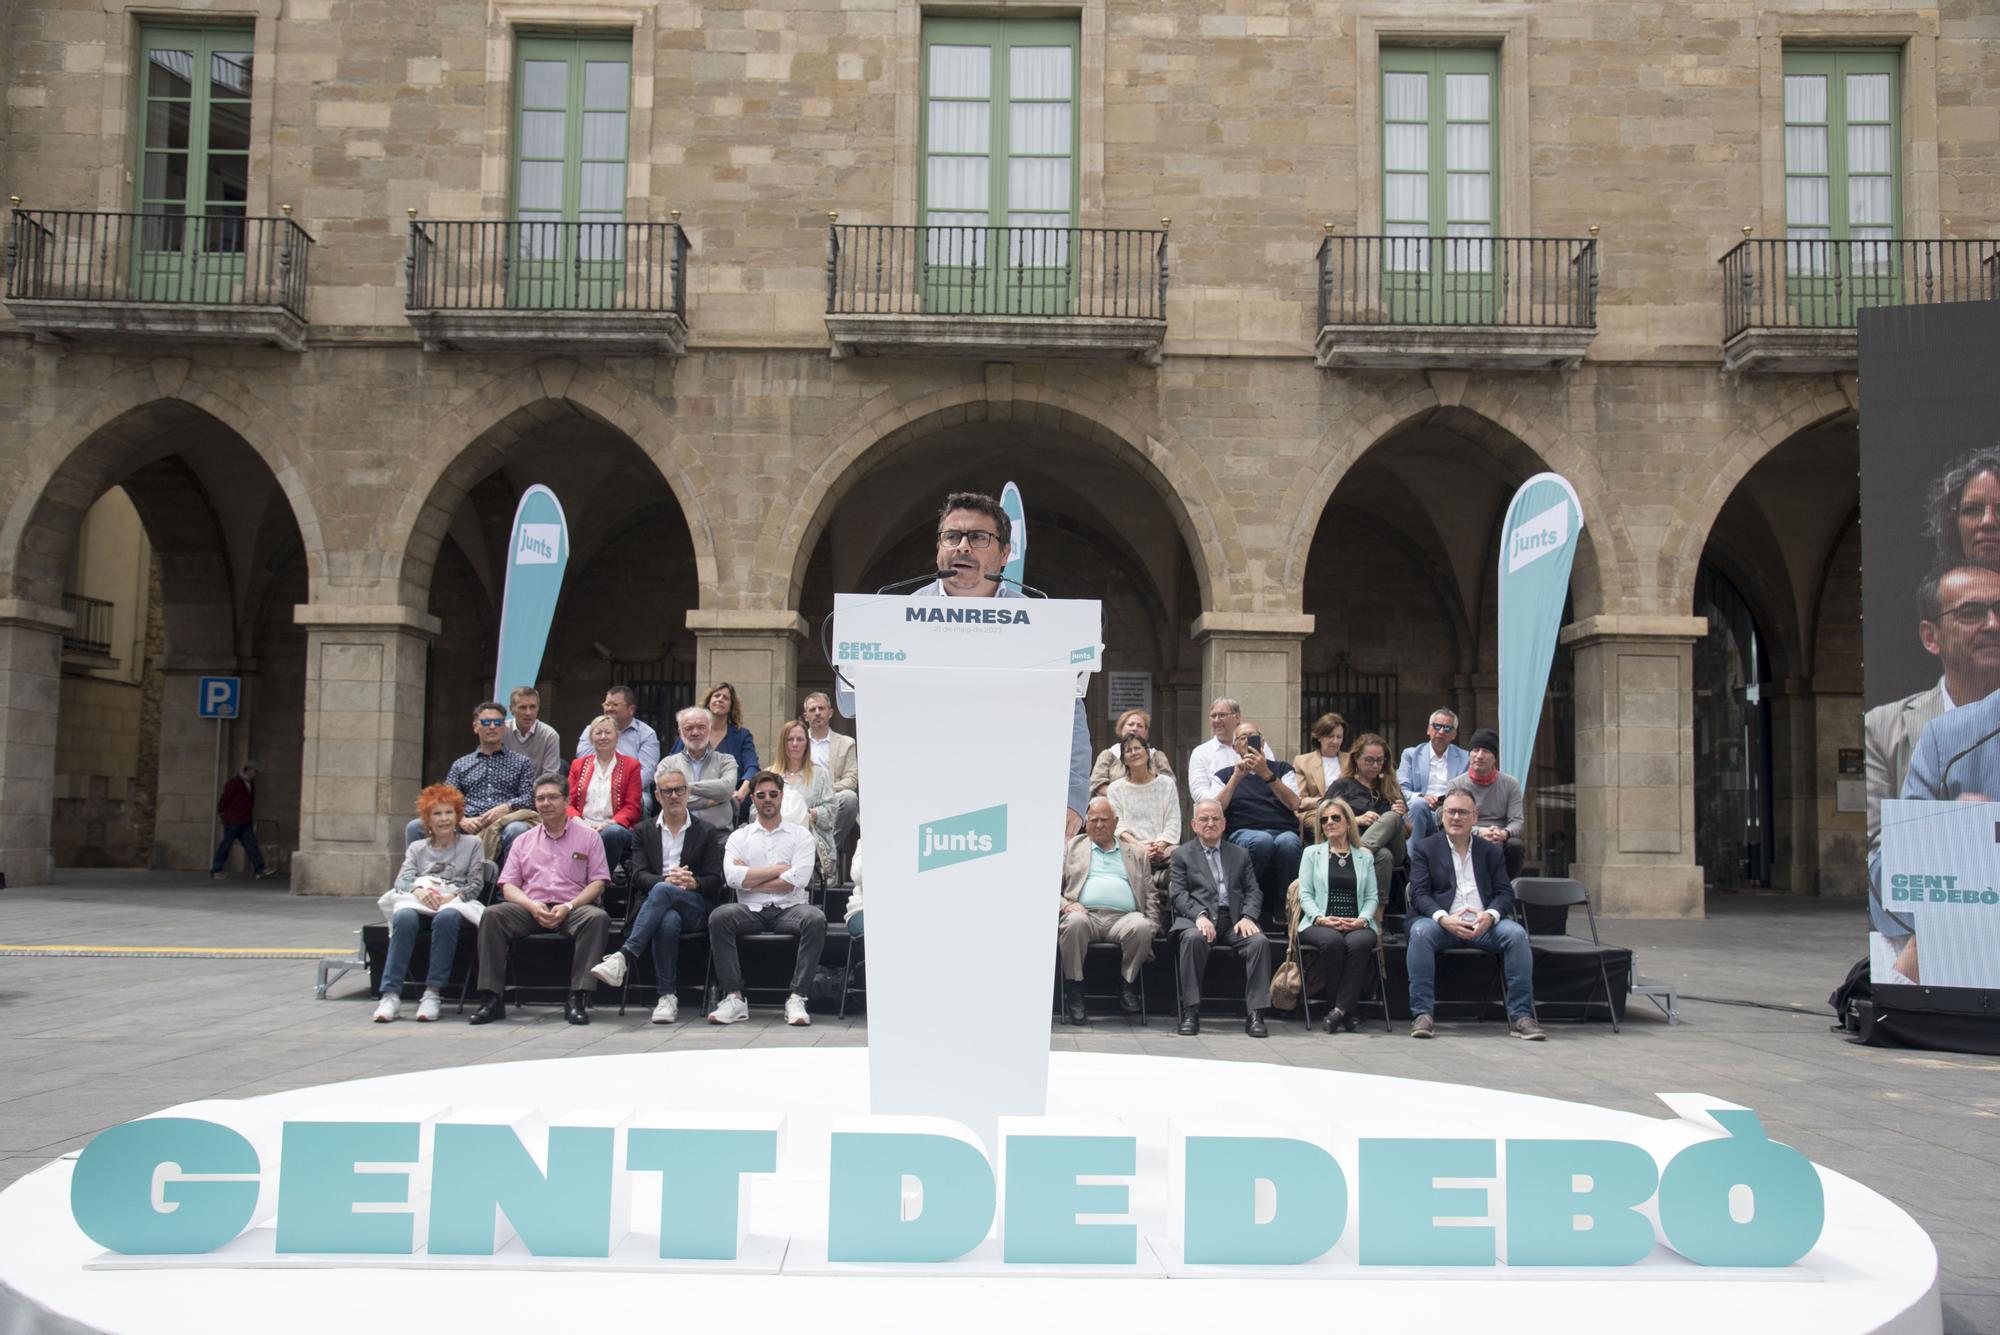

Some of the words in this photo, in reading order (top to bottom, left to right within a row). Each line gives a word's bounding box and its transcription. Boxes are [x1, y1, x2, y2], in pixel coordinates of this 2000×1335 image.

[520, 528, 552, 559] junts
[1513, 528, 1558, 559] junts
[905, 607, 1031, 625] MANRESA
[838, 642, 882, 651] GENT
[838, 651, 860, 660] DE
[862, 649, 906, 661] DEBÒ
[1071, 651, 1091, 661] junts
[207, 682, 231, 712] P
[923, 827, 993, 857] junts
[1891, 874, 1958, 889] GENT
[1891, 888, 1924, 902] DE
[1929, 886, 2000, 905] DEBÒ
[70, 1117, 778, 1260] GENT
[828, 1132, 1138, 1264] DE
[1184, 1109, 1825, 1268] DEBÒ
